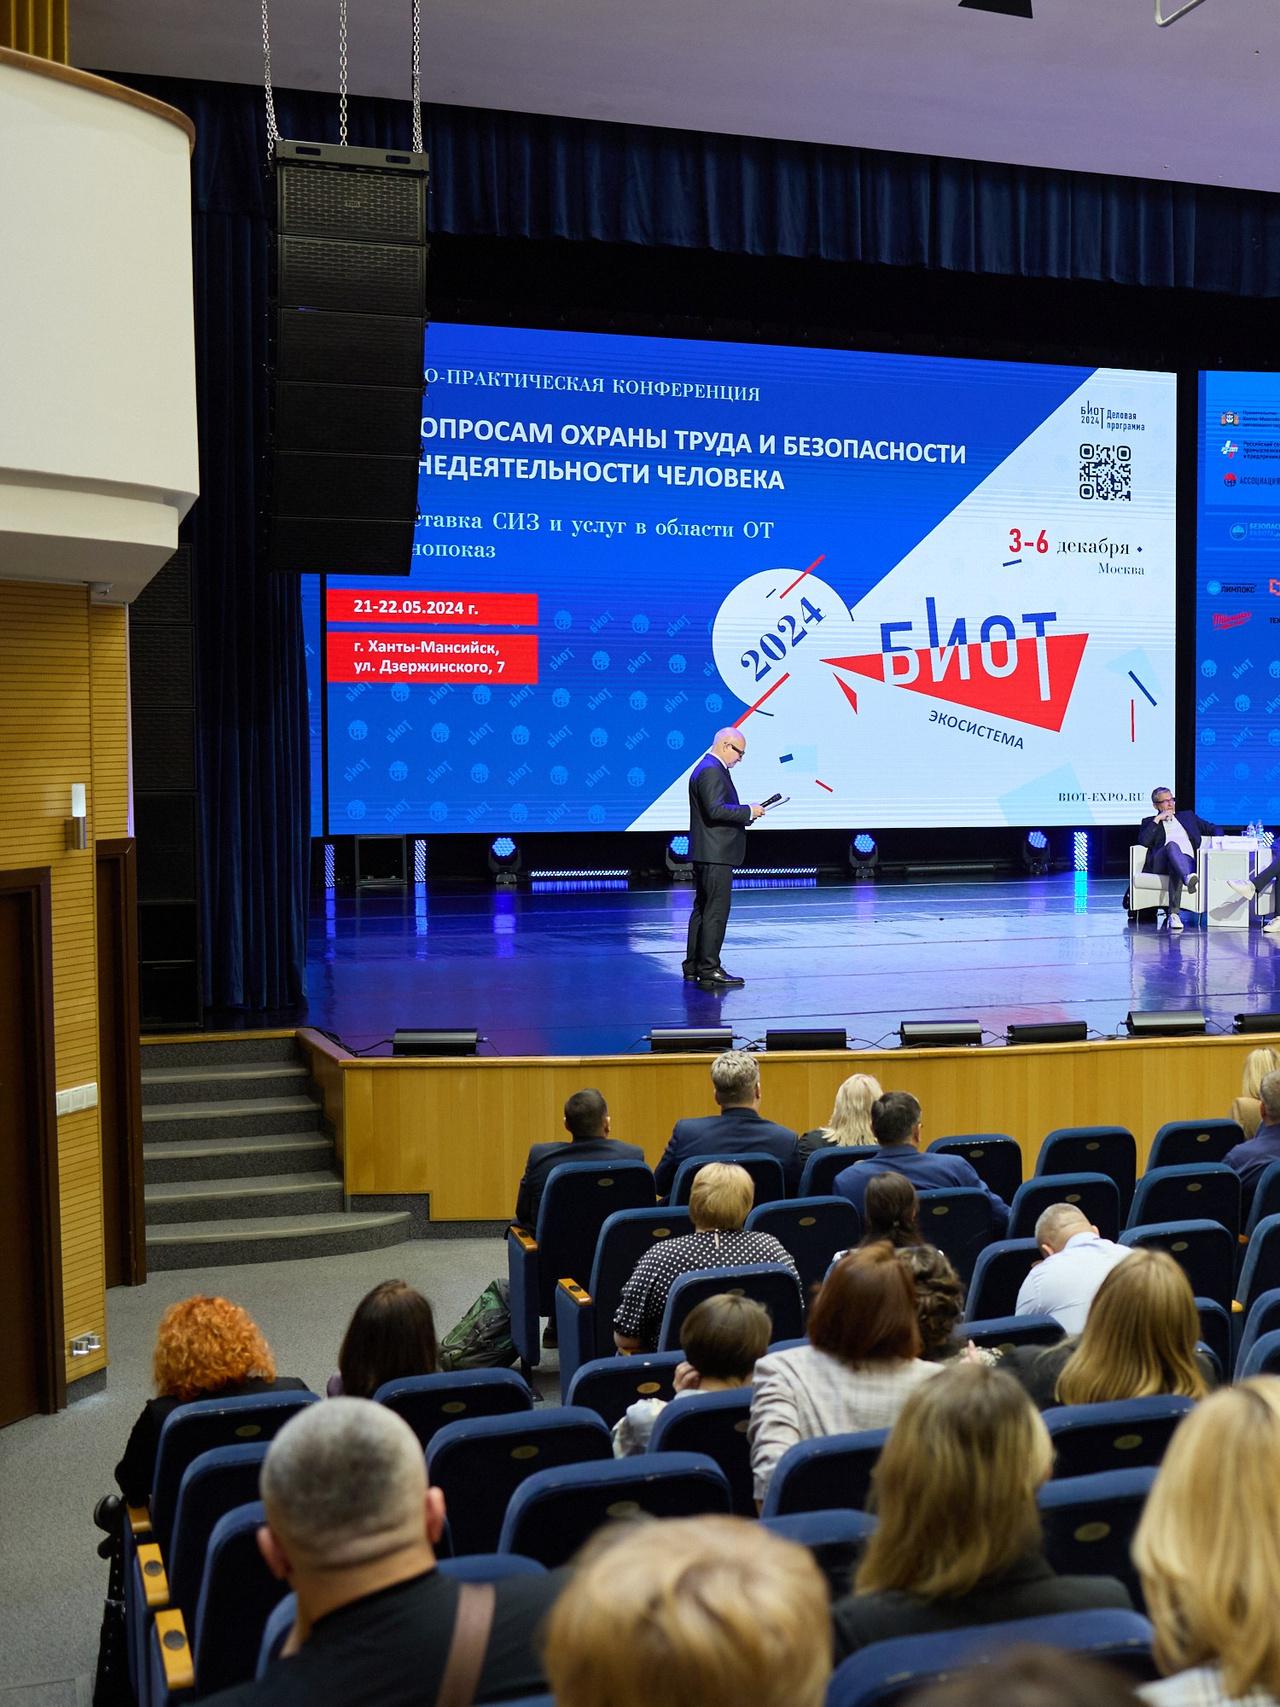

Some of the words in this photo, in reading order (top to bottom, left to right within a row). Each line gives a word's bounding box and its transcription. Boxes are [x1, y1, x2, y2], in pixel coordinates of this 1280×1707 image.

[425, 368, 605, 394] О-ПРАКТИЧЕСКАЯ
[613, 380, 760, 403] КОНФЕРЕНЦИЯ
[1081, 400, 1105, 429] БИОТ
[1081, 416, 1100, 424] 2024
[1107, 410, 1137, 420] Деловая
[1107, 422, 1146, 431] программа
[421, 416, 553, 444] ОПРОСАМ
[560, 424, 667, 449] ОХРАНЫ
[673, 429, 751, 457] ТРУДА
[759, 434, 776, 455] И
[783, 436, 966, 464] БЕЗОПАСНОСТИ
[419, 454, 650, 484] НЕДЕЯТЕЛЬНОСТИ
[657, 464, 785, 490] ЧЕЛОВЕКА
[1240, 477, 1280, 486] АССОЦИАЦИЯ
[492, 512, 540, 531] СИЗ
[549, 519, 562, 532] и
[571, 520, 627, 539] услуг
[635, 522, 647, 533] в
[655, 517, 734, 537] области
[743, 520, 775, 539] ОТ
[1008, 527, 1049, 554] 3-6
[1056, 537, 1129, 559] декабря
[1098, 562, 1145, 575] Москва
[353, 599, 464, 615] 21-22.05.2024
[468, 604, 479, 615] г.
[354, 642, 364, 652] г.
[368, 639, 500, 656] Ханты-Мансийск,
[740, 594, 826, 683] 2024
[880, 597, 1057, 702] БИОТ
[353, 661, 376, 674] ул.
[379, 659, 493, 676] Дзержинского,
[496, 661, 506, 674] 7
[928, 709, 1025, 750] ЭКОСИСТЕМА
[1058, 792, 1145, 803] BIOT-EXPO.RU
